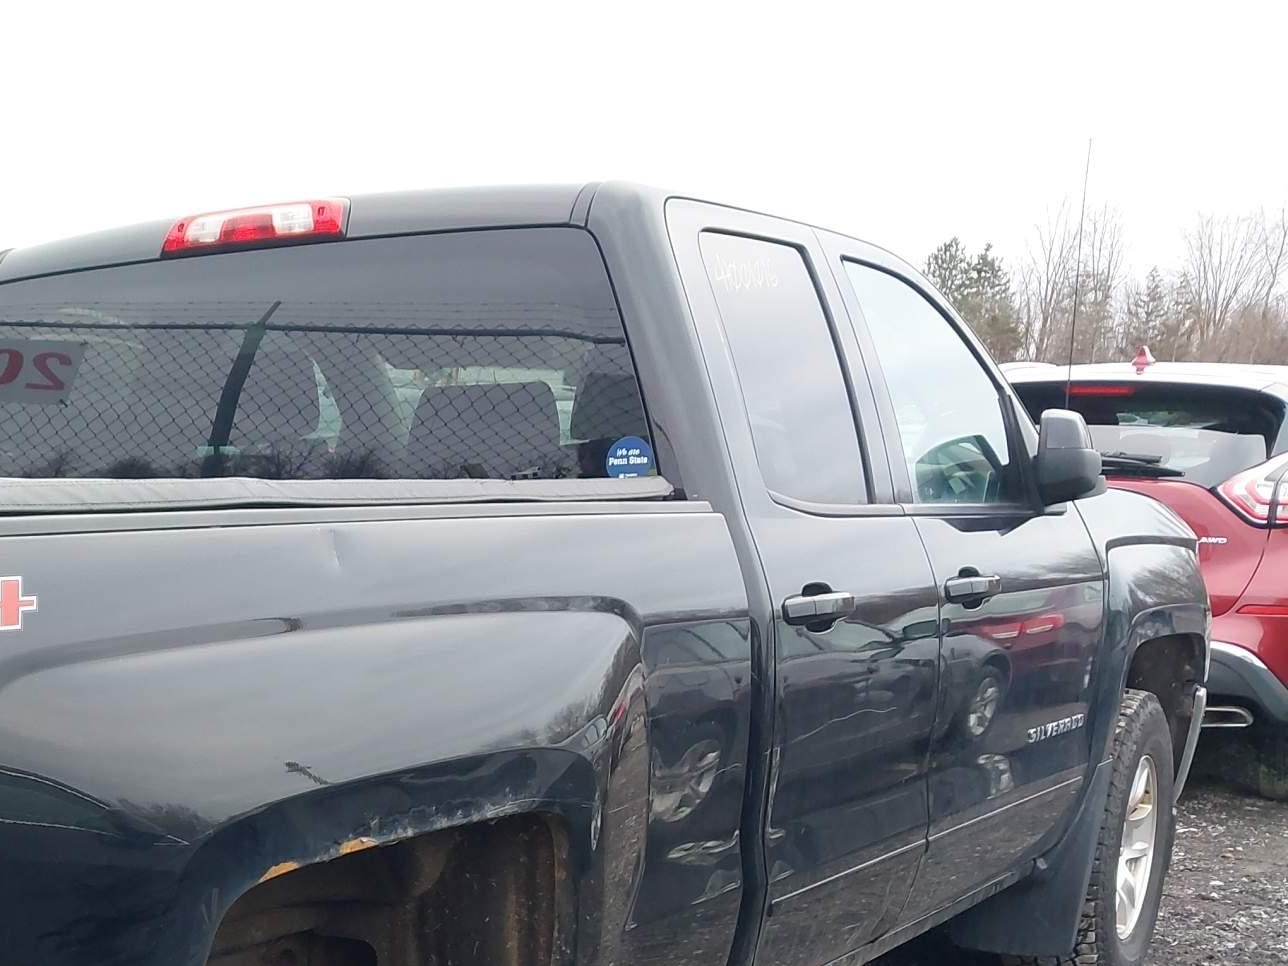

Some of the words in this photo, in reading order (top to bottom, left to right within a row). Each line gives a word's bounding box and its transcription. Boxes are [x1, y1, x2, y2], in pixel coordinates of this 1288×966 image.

[608, 456, 628, 466] Penn
[1198, 536, 1228, 544] AWD
[1027, 713, 1085, 743] SILVERADO
